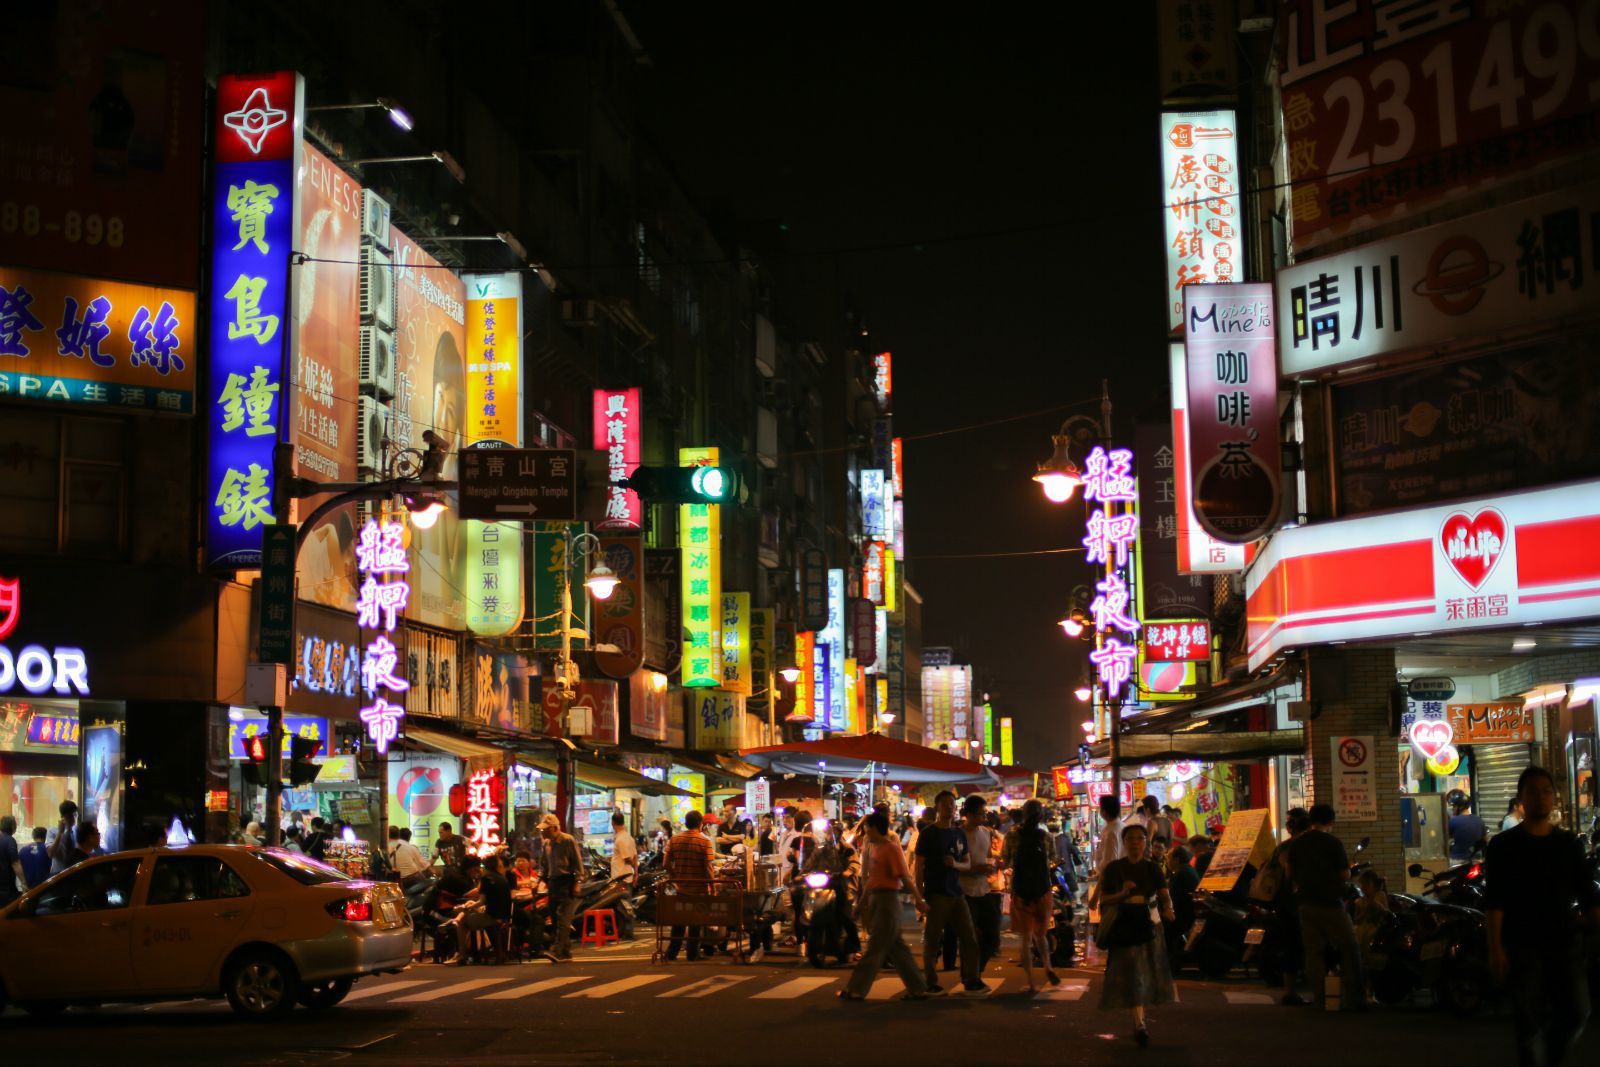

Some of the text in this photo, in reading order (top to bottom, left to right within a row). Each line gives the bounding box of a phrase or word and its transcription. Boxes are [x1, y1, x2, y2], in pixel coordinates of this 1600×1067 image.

[1179, 127, 1189, 145] KEY
[1291, 255, 1402, 351] 晴川
[215, 180, 280, 531] 寶島鐘錶
[1216, 350, 1252, 479] 咖啡茶
[486, 455, 568, 478] 青山宮
[502, 486, 538, 499] Qingshan
[541, 486, 568, 499] Temple
[481, 525, 499, 613] 台灣彩券
[1445, 594, 1509, 621] 萊爾富
